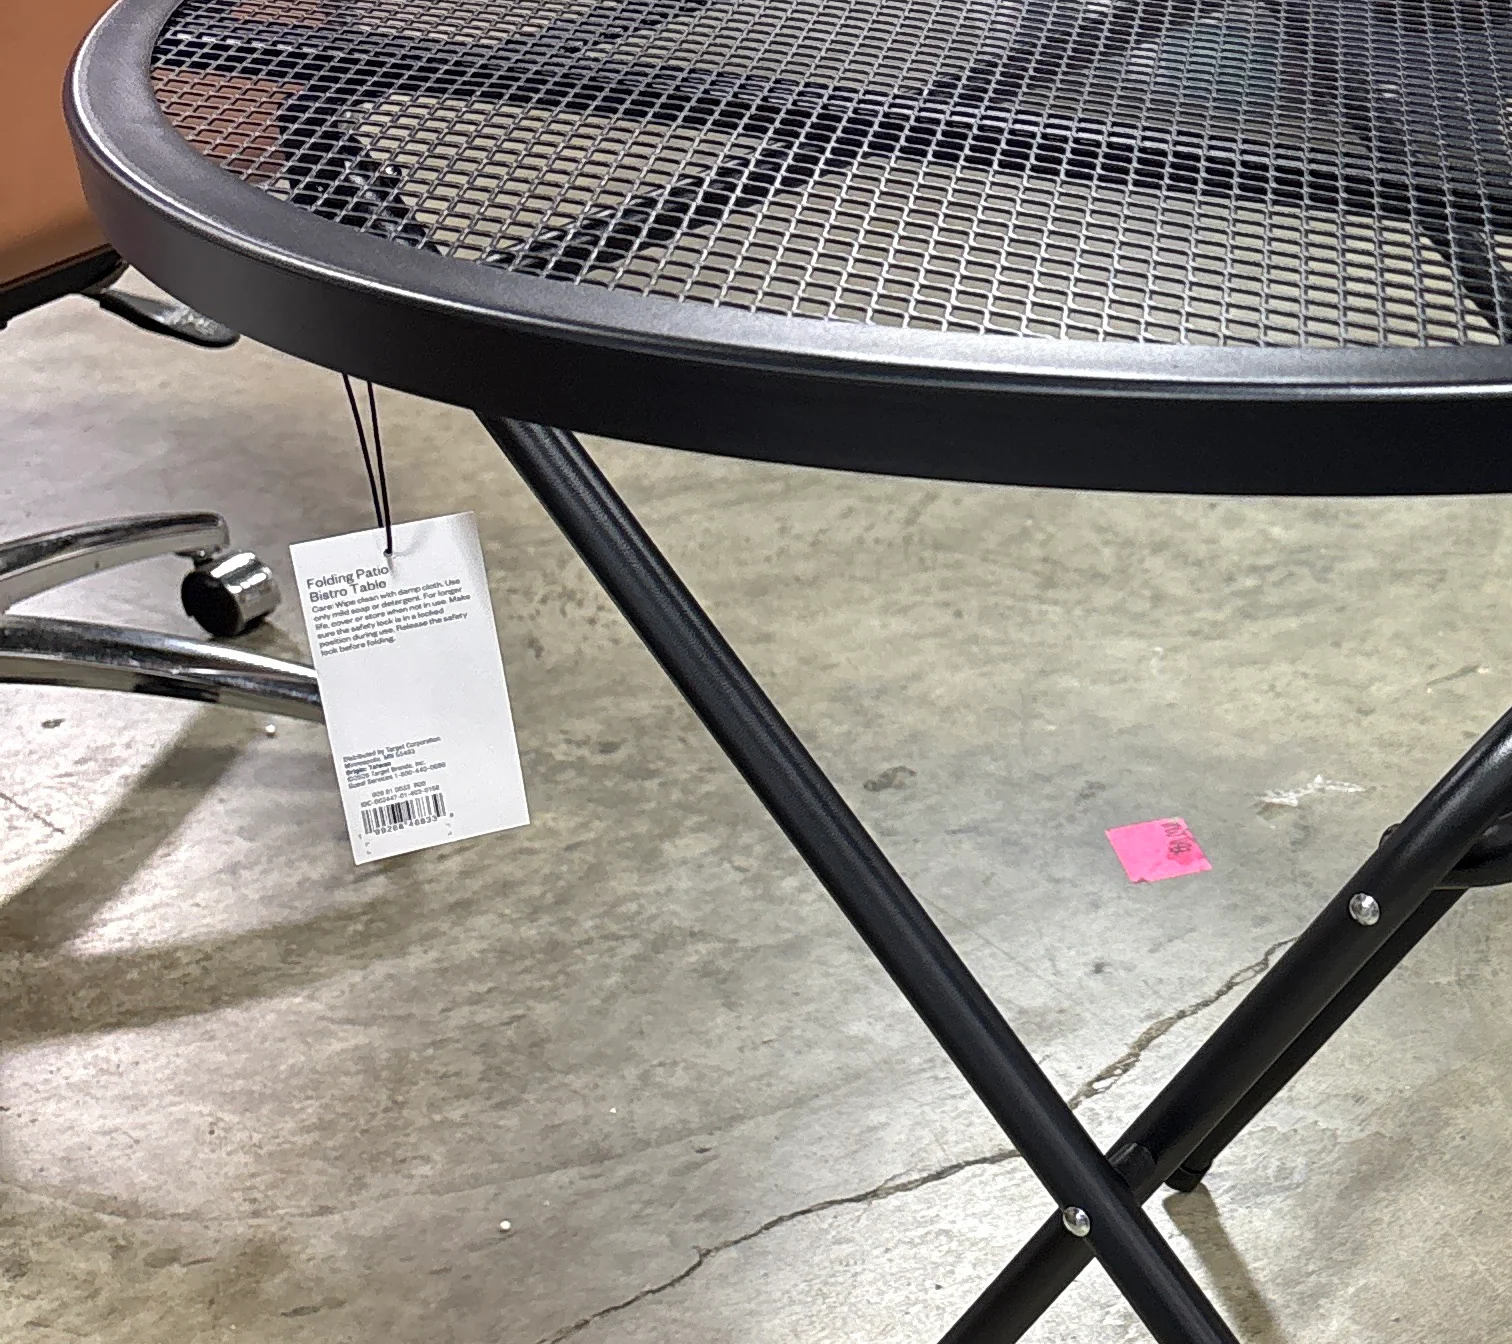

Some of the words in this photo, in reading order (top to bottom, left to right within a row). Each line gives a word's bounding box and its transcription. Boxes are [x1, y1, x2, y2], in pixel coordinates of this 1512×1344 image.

[307, 572, 354, 589] Folding
[356, 564, 389, 579] Patio
[310, 589, 347, 602] Bistro
[351, 580, 386, 594] Table
[332, 609, 349, 618] mild
[438, 587, 462, 596] longer
[335, 600, 355, 608] Wipe
[357, 595, 379, 604] clean
[380, 591, 396, 599] with
[398, 587, 421, 595] damp
[422, 582, 444, 591] cloth.
[449, 595, 470, 603] Make
[418, 608, 444, 618] locked
[353, 631, 378, 640] during
[396, 621, 428, 631] Release
[443, 613, 467, 622] safety
[339, 643, 365, 652] before
